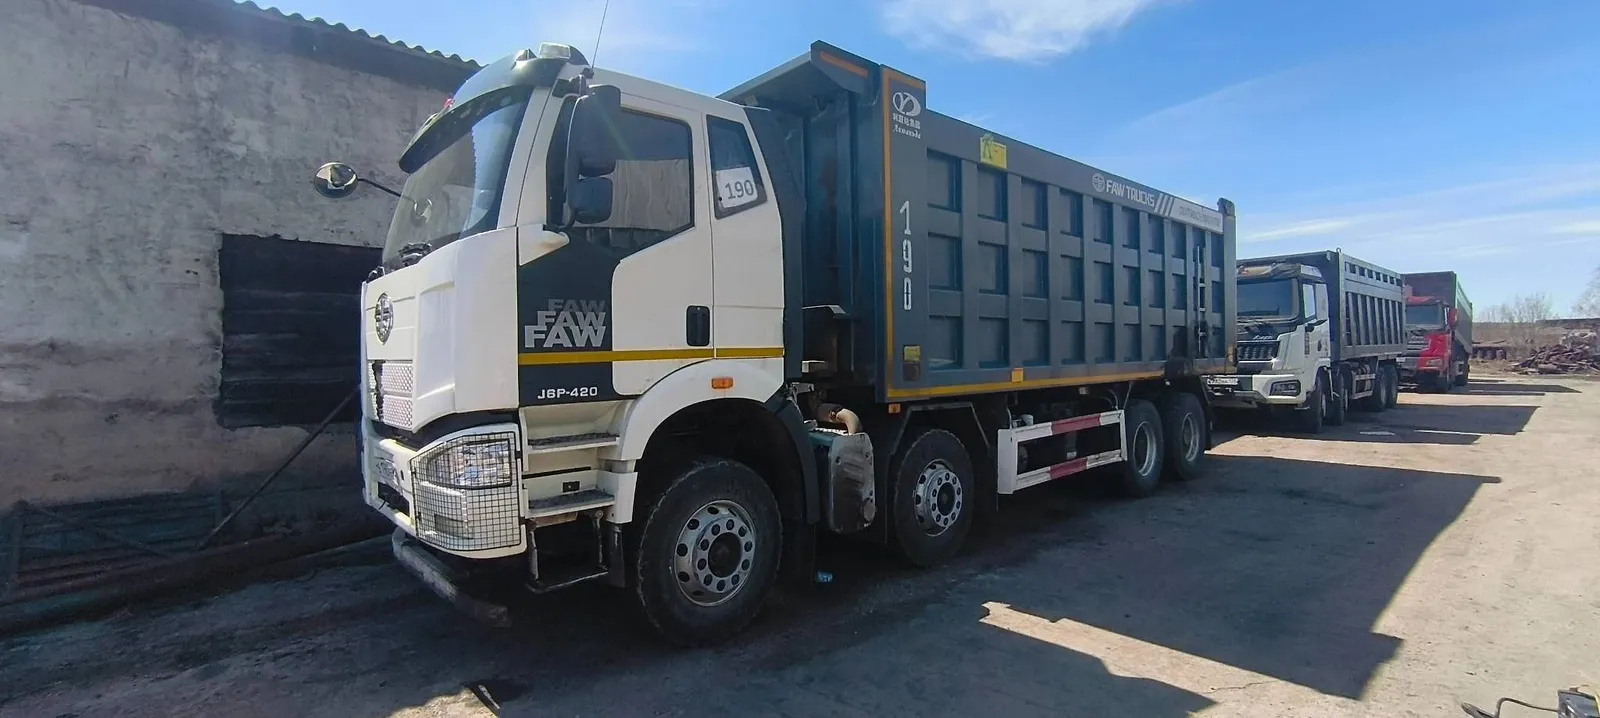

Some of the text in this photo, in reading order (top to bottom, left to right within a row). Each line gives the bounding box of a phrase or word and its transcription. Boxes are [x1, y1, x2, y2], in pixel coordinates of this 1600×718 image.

[725, 180, 754, 199] 190
[1106, 180, 1155, 207] FAW TRUCKS
[899, 200, 912, 310] 190
[547, 299, 606, 313] FAW
[537, 311, 606, 327] FAW
[524, 325, 606, 348] FAW
[537, 386, 598, 399] J6P-420
